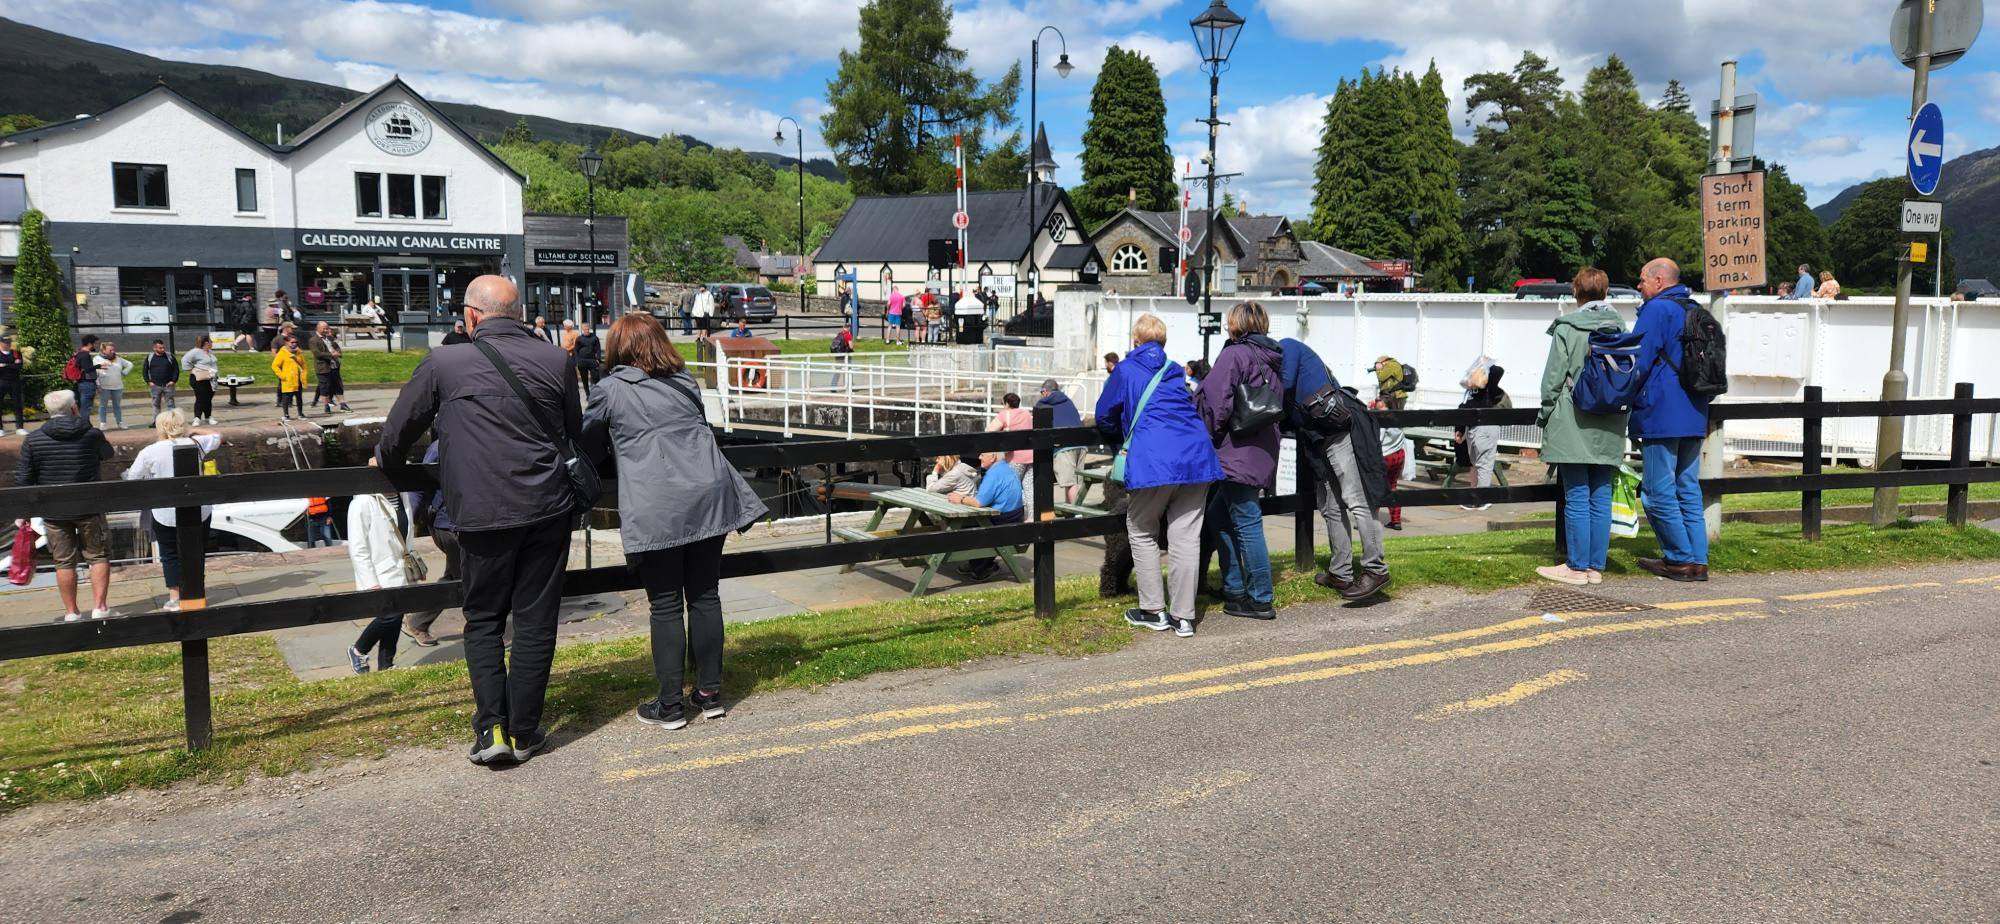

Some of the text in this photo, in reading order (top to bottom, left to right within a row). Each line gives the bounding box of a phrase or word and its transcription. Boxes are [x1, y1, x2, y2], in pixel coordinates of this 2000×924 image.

[1713, 180, 1752, 196] Short
[1717, 200, 1751, 213] term
[1708, 215, 1760, 232] parking
[1906, 209, 1939, 227] One way
[301, 233, 501, 250] CALEDONIAN CANAL CENTRE
[1719, 232, 1749, 246] only
[538, 252, 566, 260] KILTANE
[1709, 253, 1761, 268] 30 min.
[993, 276, 1003, 285] THE
[1719, 272, 1753, 283] max.
